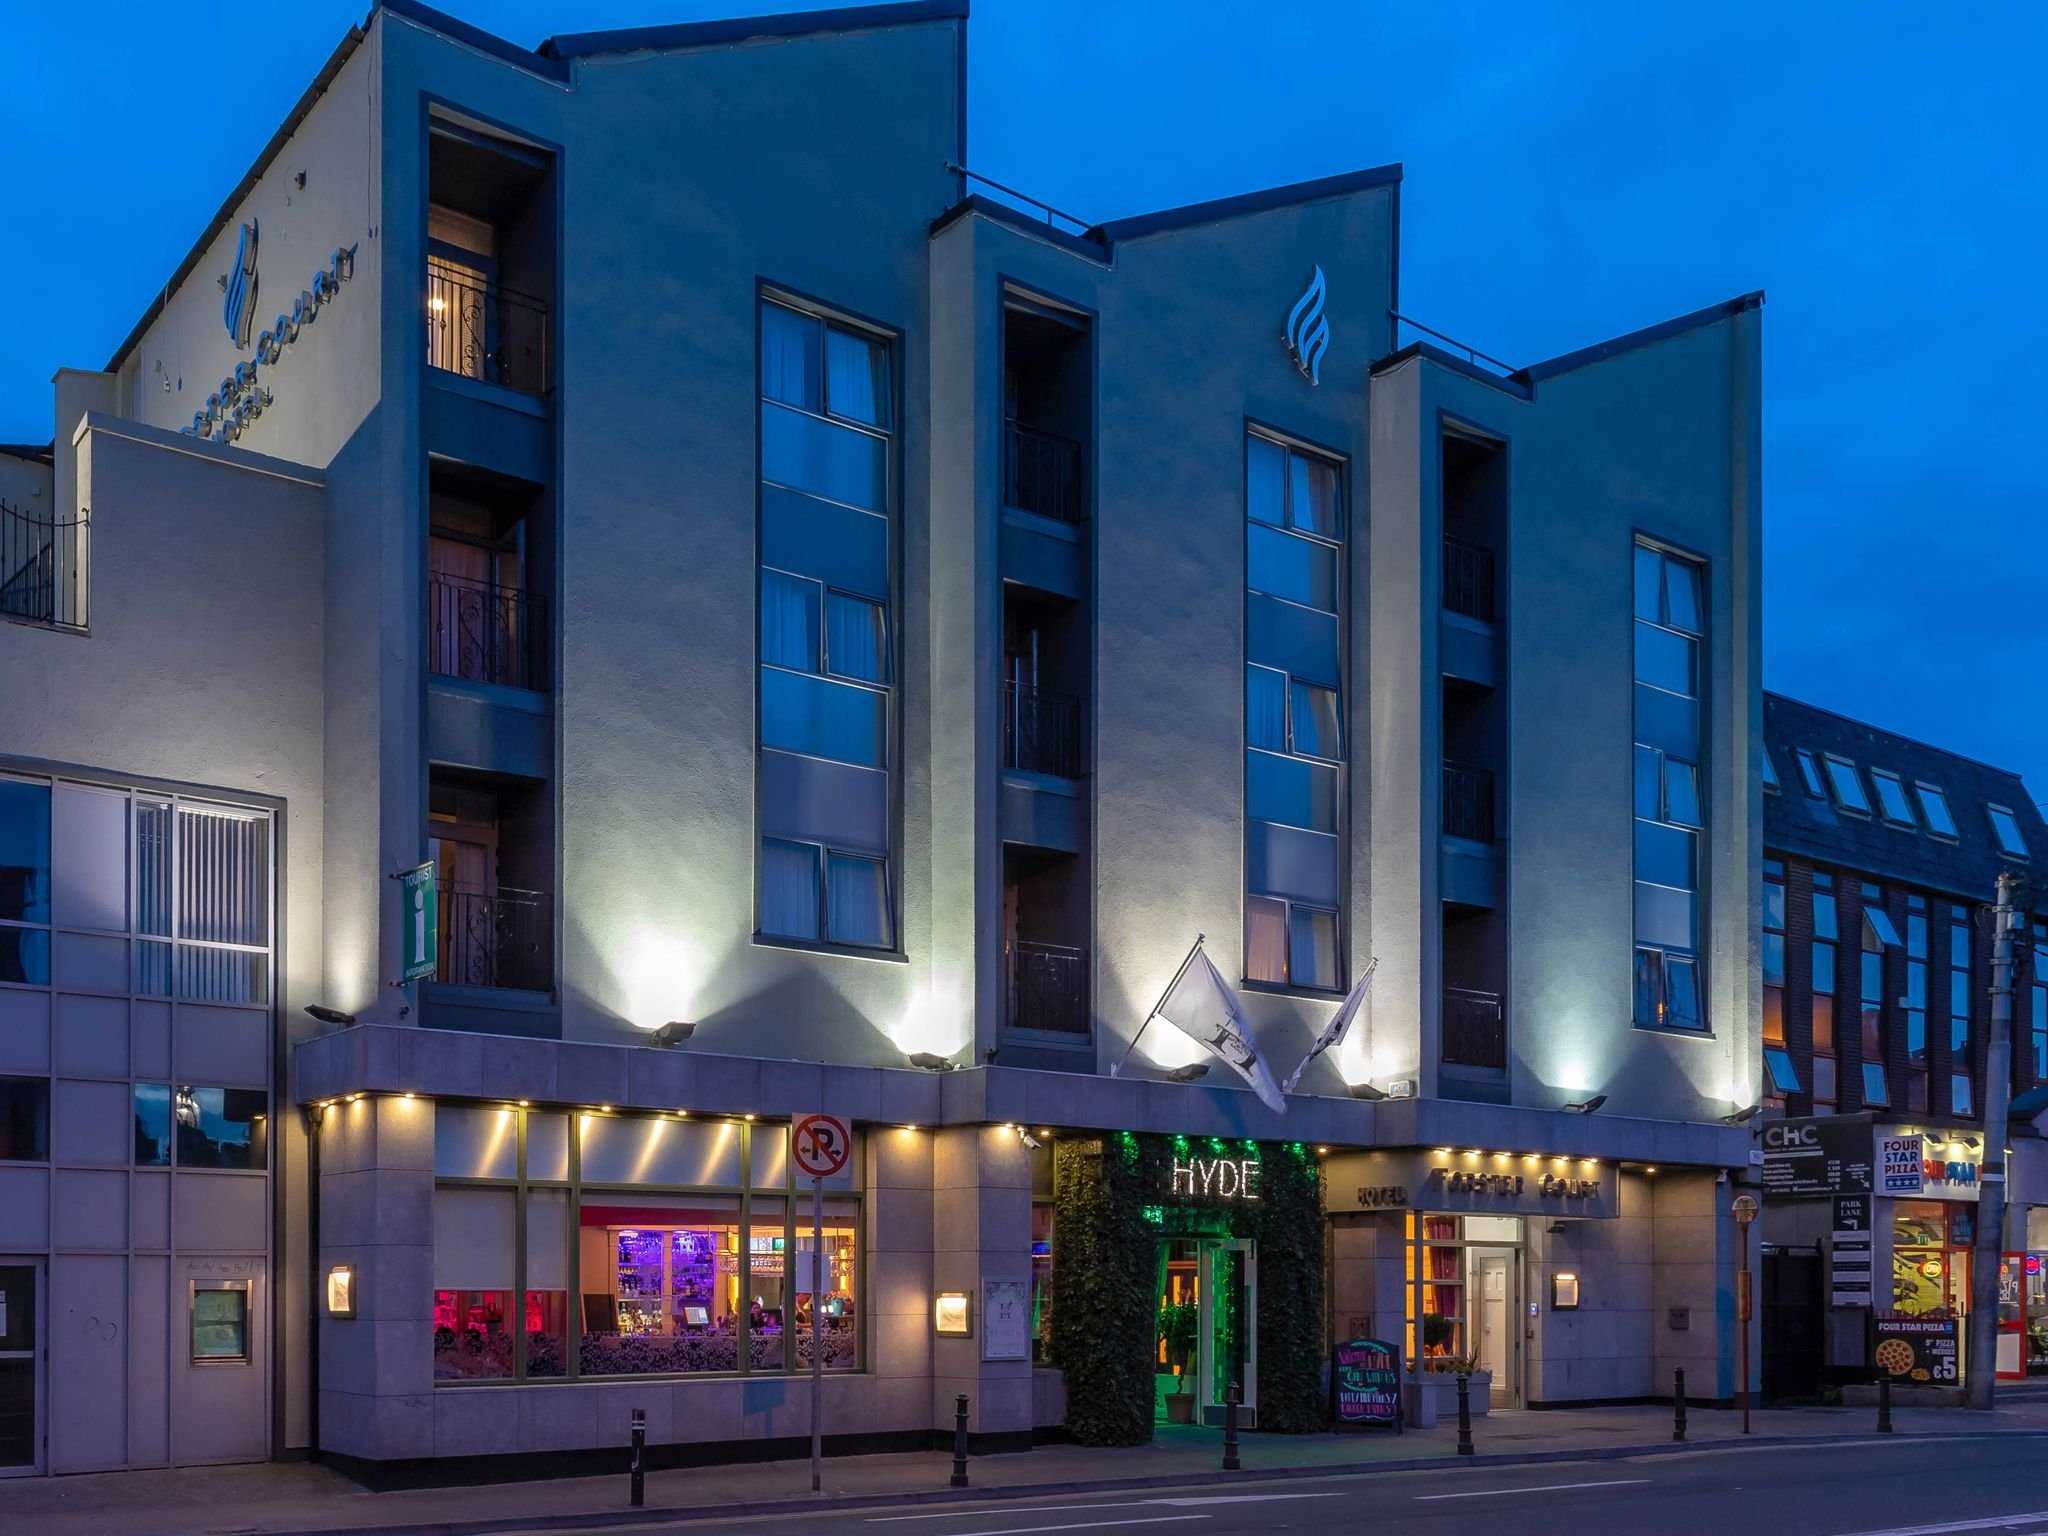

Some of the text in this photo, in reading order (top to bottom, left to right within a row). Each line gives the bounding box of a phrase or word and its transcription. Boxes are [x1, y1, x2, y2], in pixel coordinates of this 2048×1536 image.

[1765, 1125, 1819, 1146] CHC
[1884, 1140, 1919, 1152] FOUR
[1885, 1151, 1918, 1163] STAR
[1884, 1163, 1919, 1175] PIZZA
[1172, 1157, 1260, 1199] HYDE
[1538, 1172, 1600, 1200] COURT
[1358, 1186, 1408, 1207] HOTEL
[1878, 1322, 1901, 1332] FOUR
[1902, 1323, 1921, 1332] STAR
